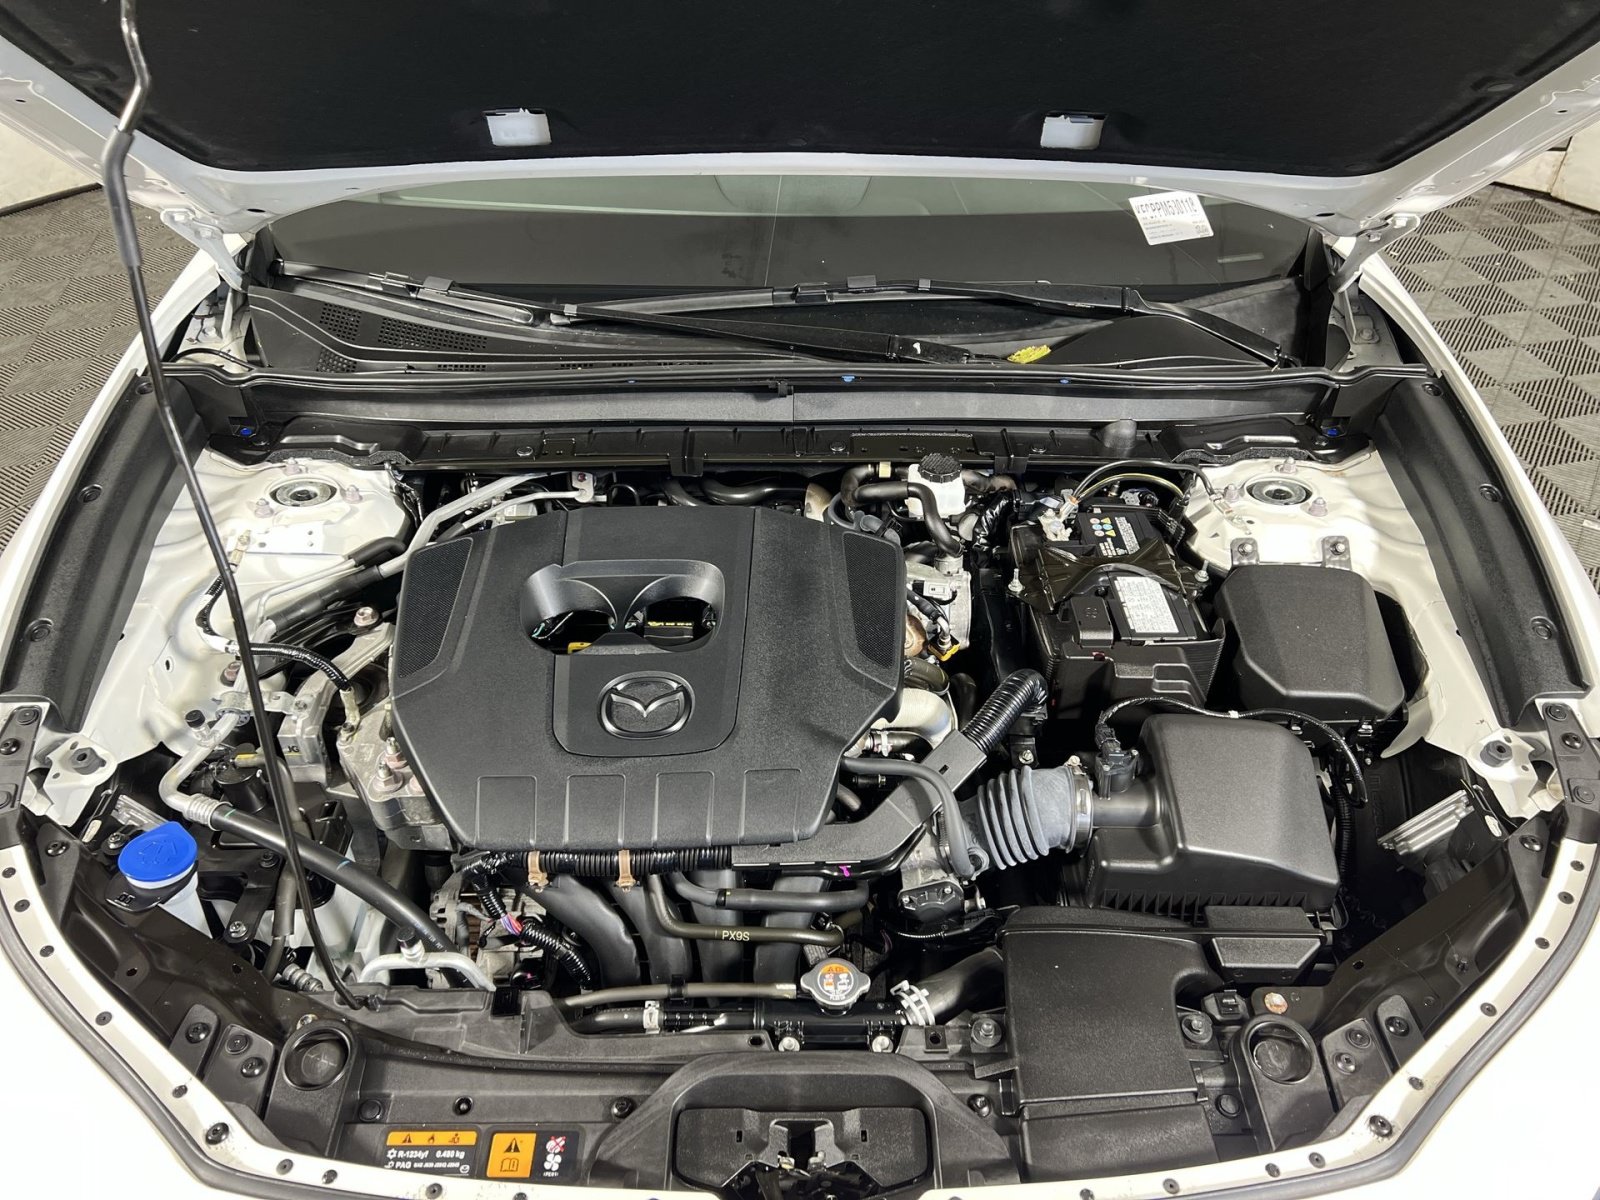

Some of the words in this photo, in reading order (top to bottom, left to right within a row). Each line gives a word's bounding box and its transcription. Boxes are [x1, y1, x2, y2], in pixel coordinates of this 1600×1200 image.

[721, 930, 750, 942] PX9S
[397, 1150, 430, 1160] R-1234yf
[455, 1150, 465, 1160] kg
[395, 1161, 412, 1169] PAG
